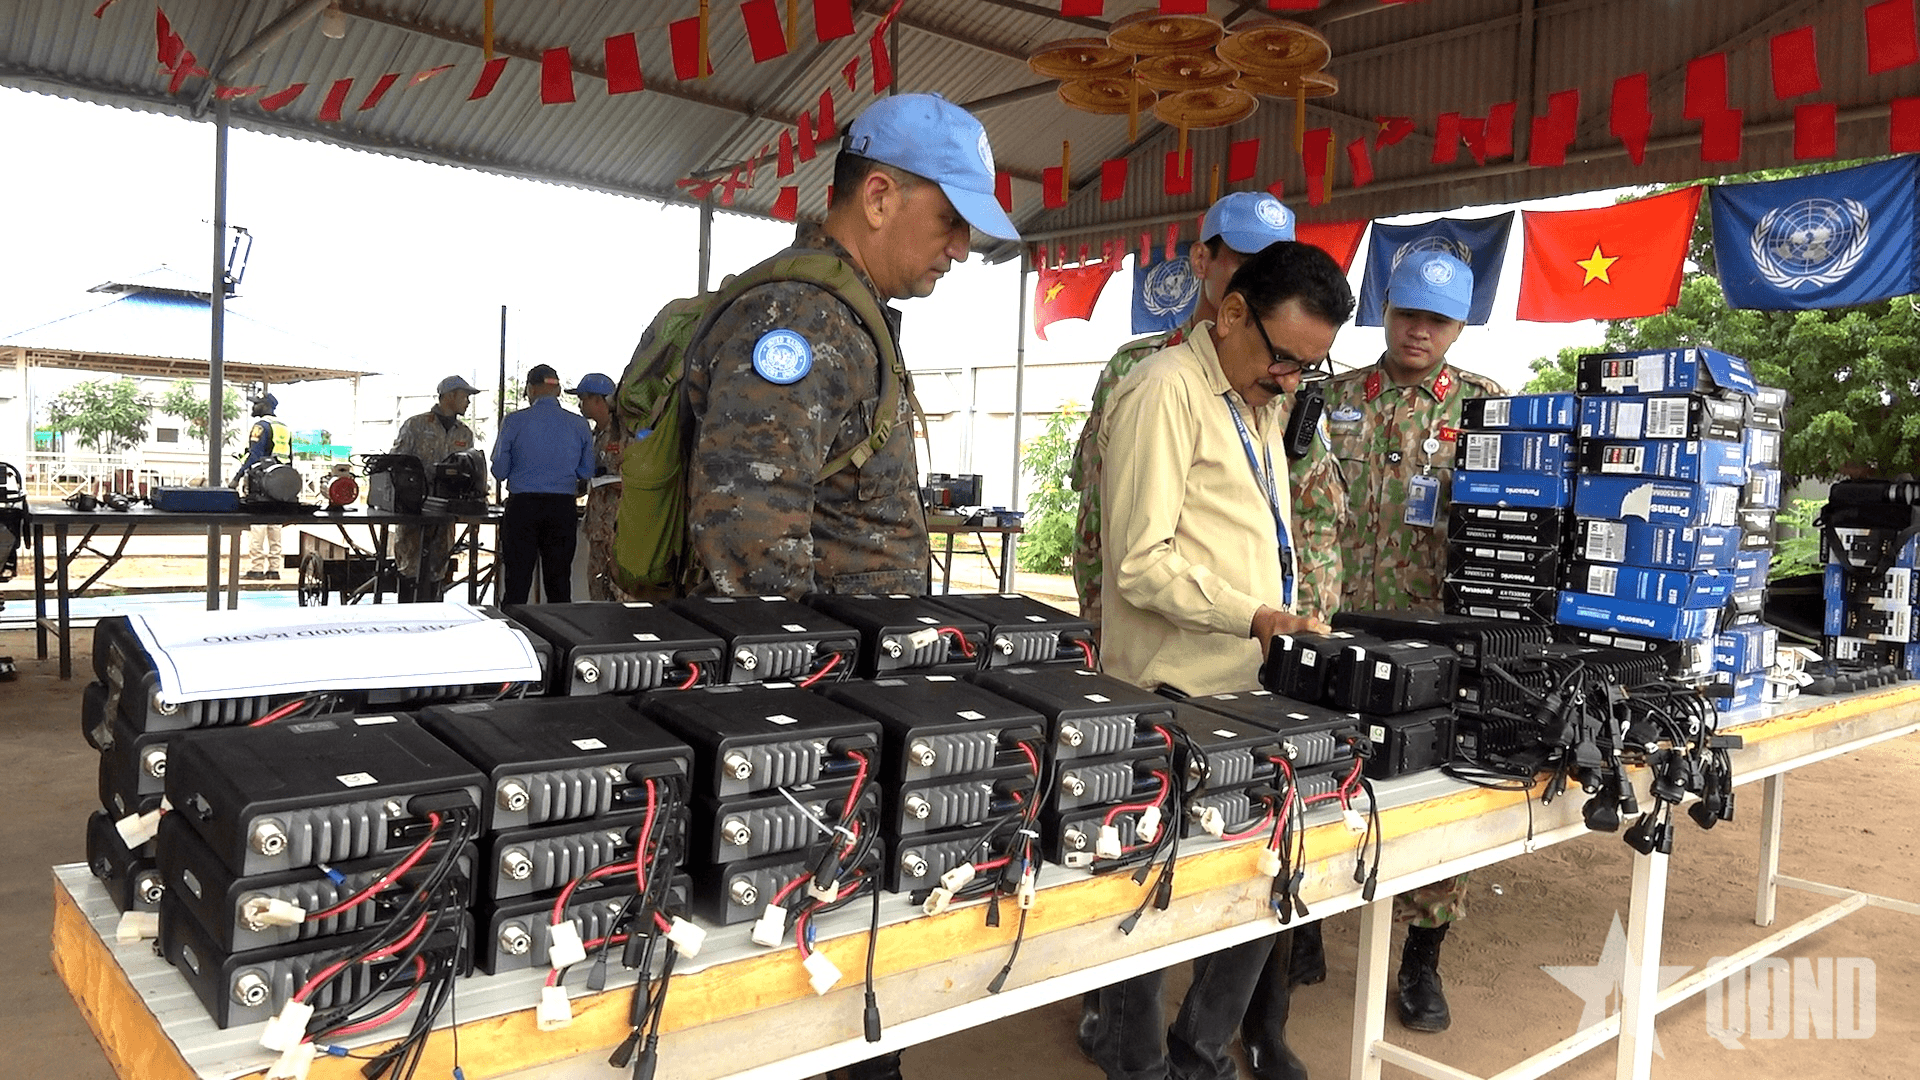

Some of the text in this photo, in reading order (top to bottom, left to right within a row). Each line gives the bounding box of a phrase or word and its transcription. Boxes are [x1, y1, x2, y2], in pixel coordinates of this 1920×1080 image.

[1668, 352, 1677, 387] Panasonic
[1669, 443, 1680, 477] Panasonic
[1505, 487, 1540, 497] Panasonic
[1502, 533, 1537, 543] Panasonic
[1665, 528, 1676, 565] Panasonic
[1500, 573, 1535, 583] Panasonic
[1461, 585, 1494, 595] Panasonic
[1616, 614, 1656, 628] Panasonic
[203, 632, 289, 644] RADIO
